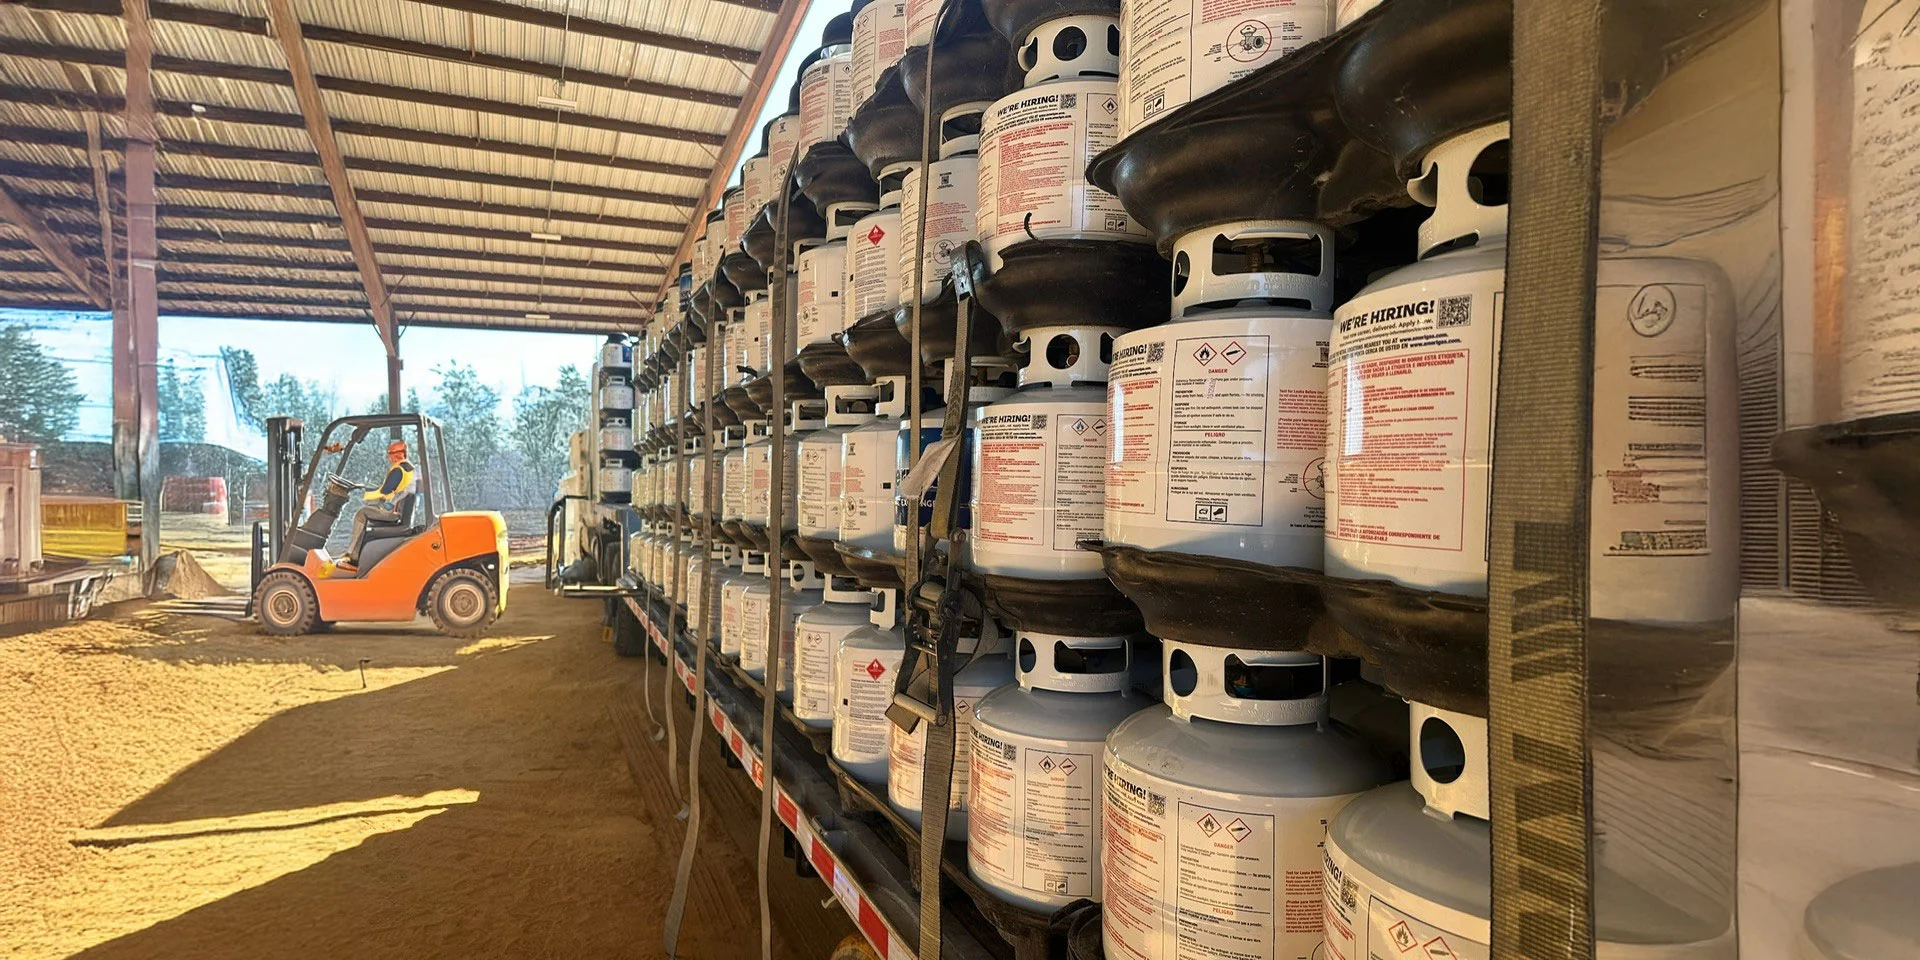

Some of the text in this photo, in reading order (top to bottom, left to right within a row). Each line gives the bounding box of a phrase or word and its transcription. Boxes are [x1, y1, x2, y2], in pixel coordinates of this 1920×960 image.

[998, 95, 1059, 117] WE'RE HIRING!
[1340, 300, 1435, 333] WE'RE HIRING!
[999, 415, 1031, 423] HIRING!
[1114, 774, 1146, 800] HIRING!
[1212, 907, 1234, 916] PELIGRO
